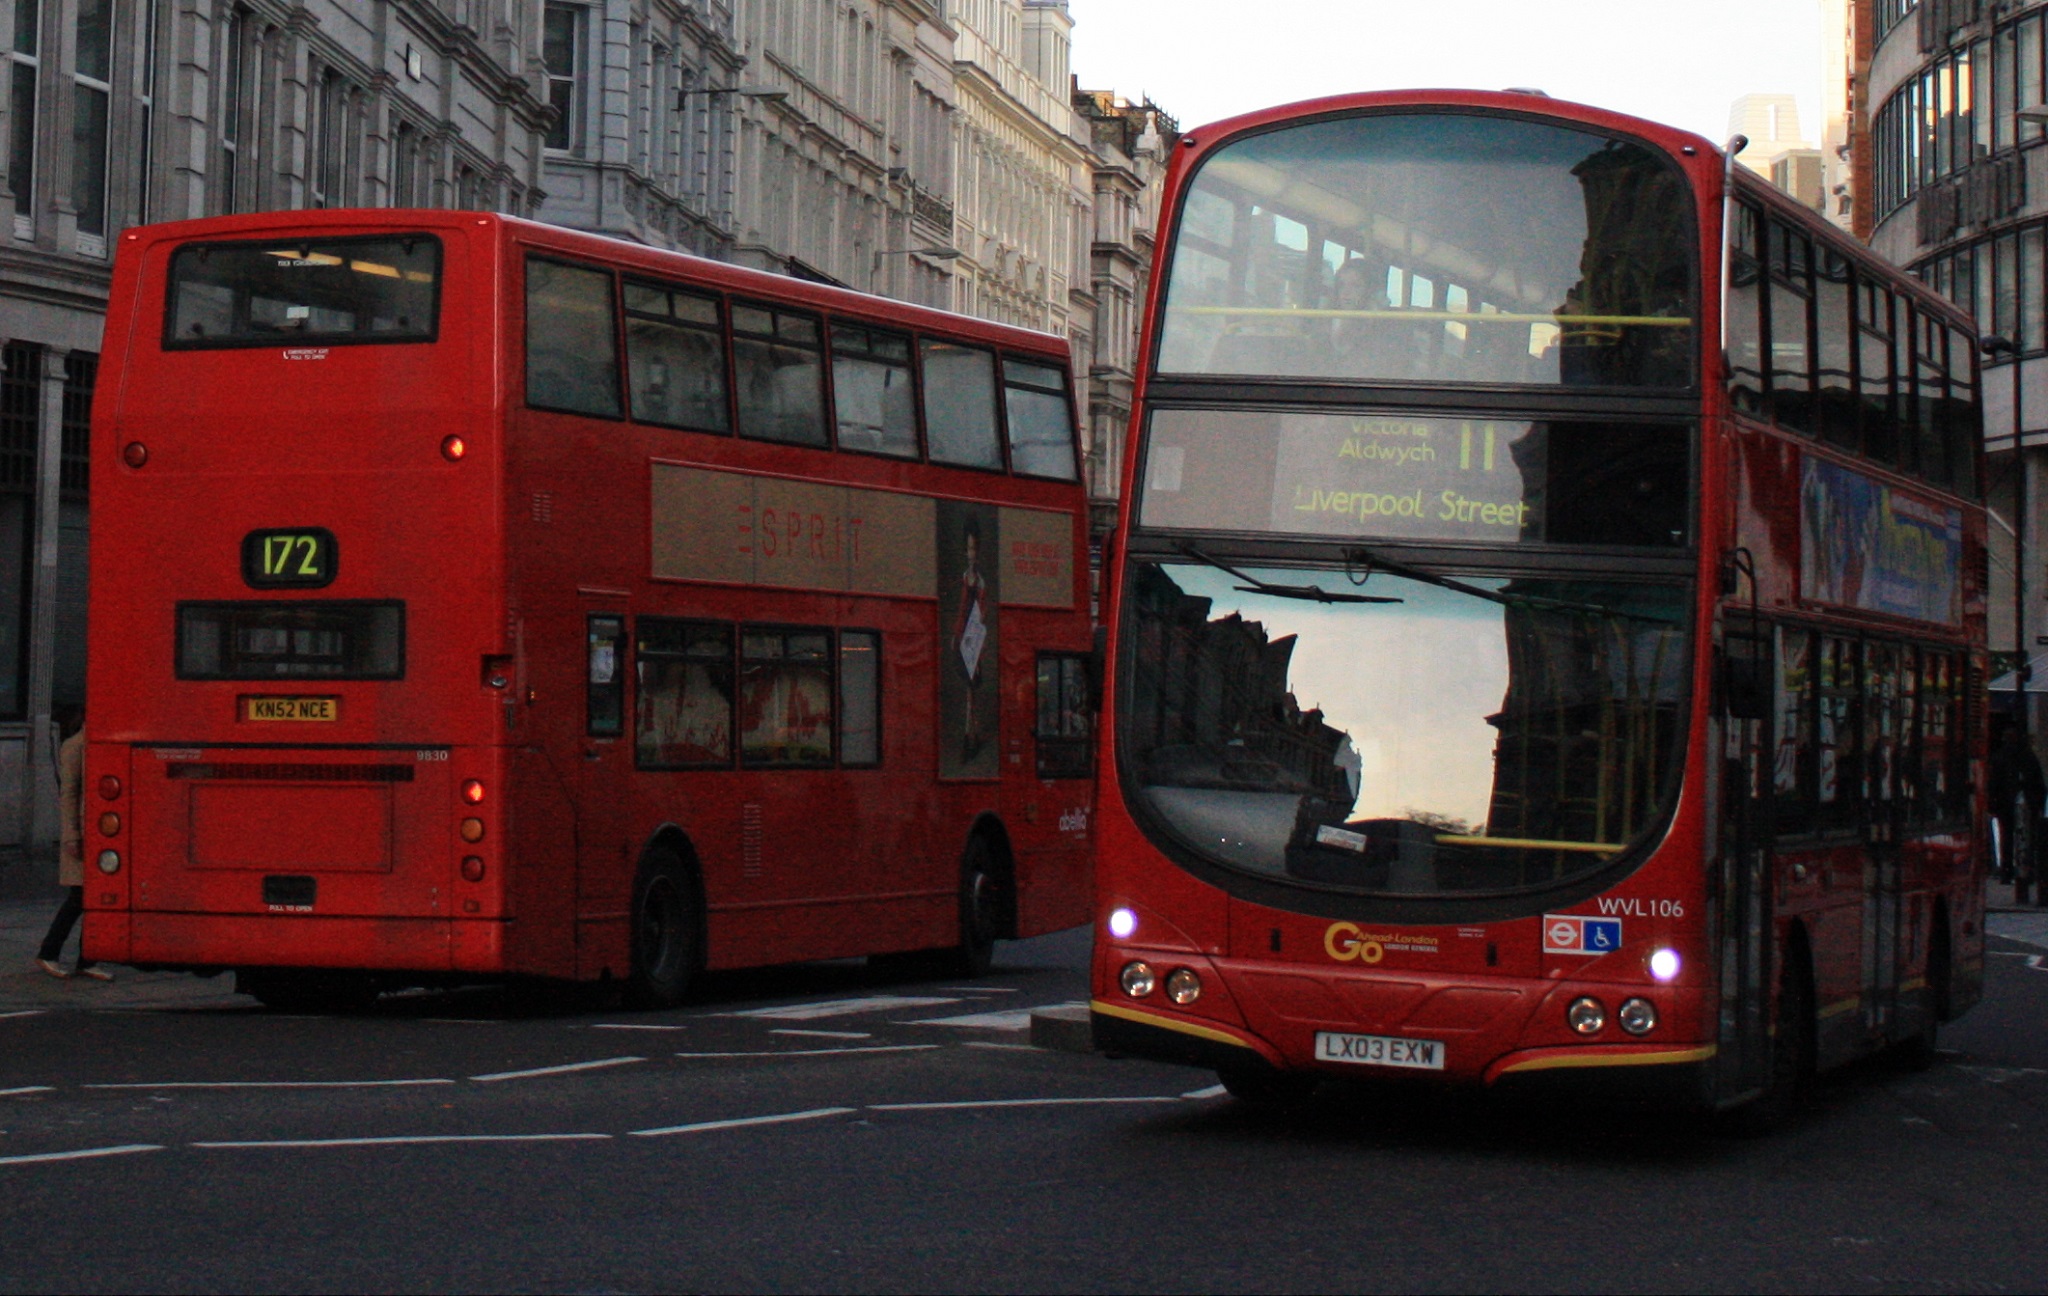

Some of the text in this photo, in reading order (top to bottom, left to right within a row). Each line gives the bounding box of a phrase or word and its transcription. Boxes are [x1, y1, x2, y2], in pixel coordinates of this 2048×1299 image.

[1338, 438, 1436, 466] Aldwych
[1459, 421, 1495, 471] 11
[1294, 484, 1531, 528] Liverpool Street
[738, 504, 863, 570] ESPRIT
[264, 534, 319, 575] 172
[255, 701, 330, 718] KN52 NCE
[416, 750, 448, 761] 9830
[1059, 807, 1087, 831] abellio
[1597, 896, 1685, 918] WVL106
[1326, 1035, 1434, 1064] LX03 EXW
